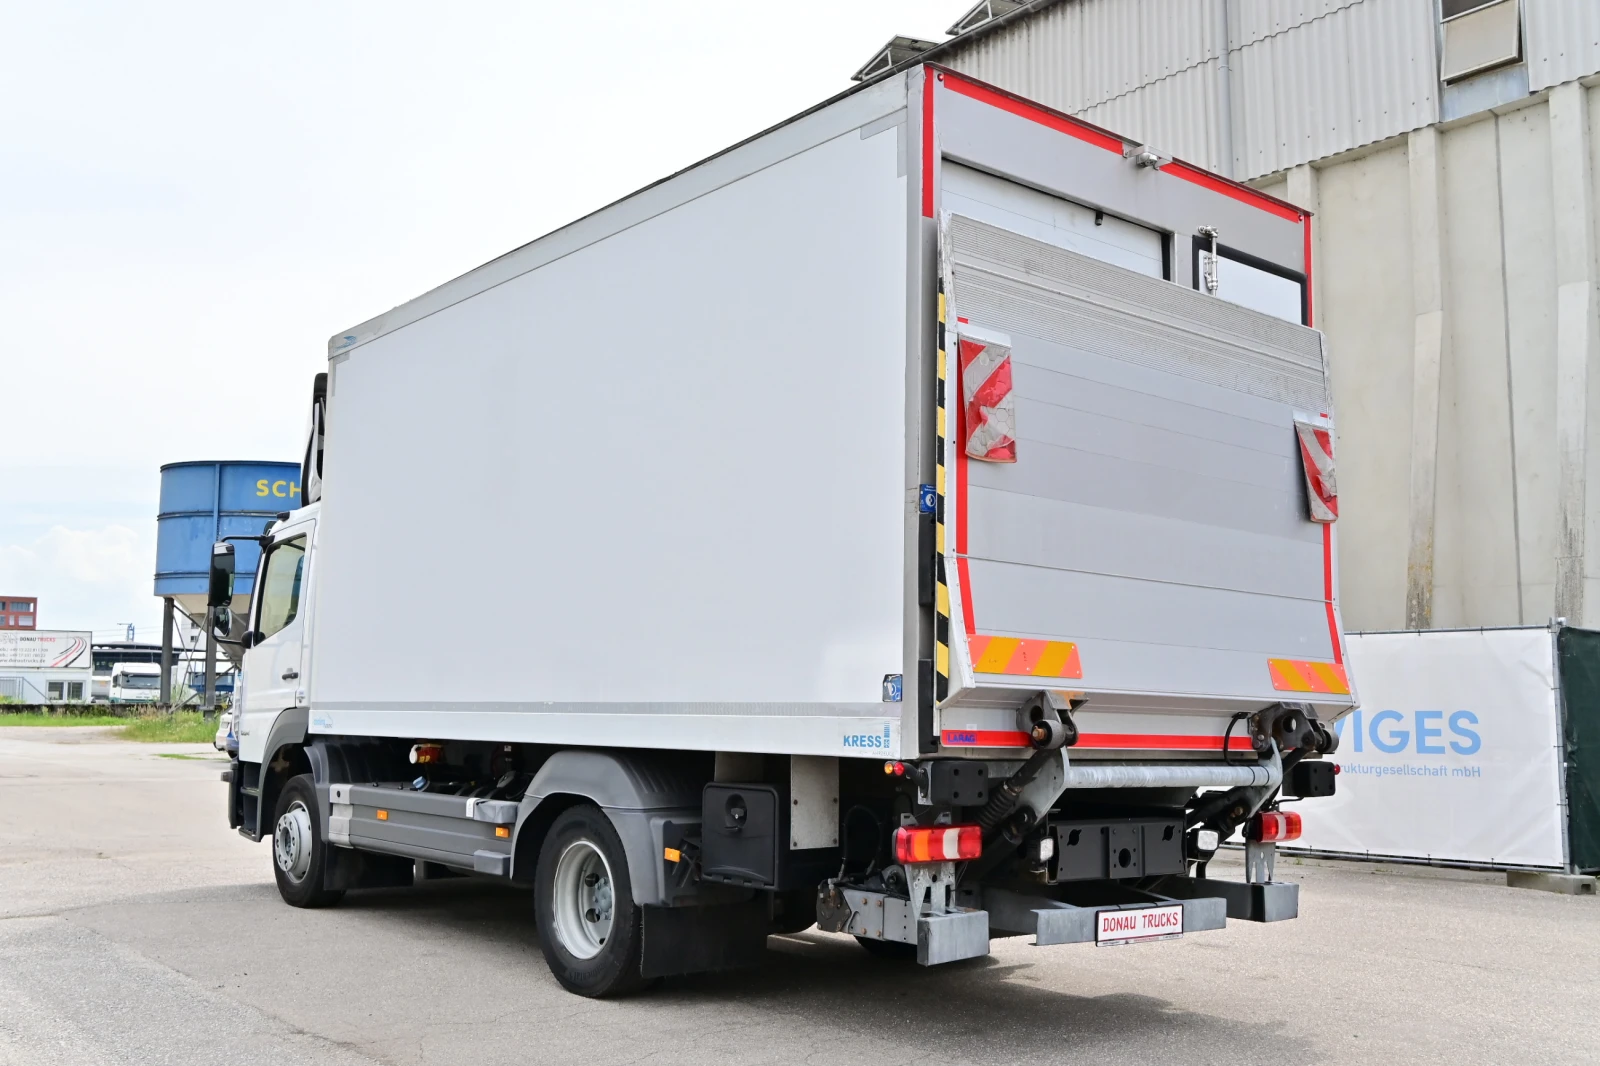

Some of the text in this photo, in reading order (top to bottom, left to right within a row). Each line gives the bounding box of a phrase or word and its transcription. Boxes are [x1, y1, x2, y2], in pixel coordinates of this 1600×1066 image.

[843, 735, 882, 748] KRESS
[947, 733, 975, 743] LARAG
[1452, 766, 1481, 778] mbH
[1102, 912, 1178, 932] DONAU TRUCKS
